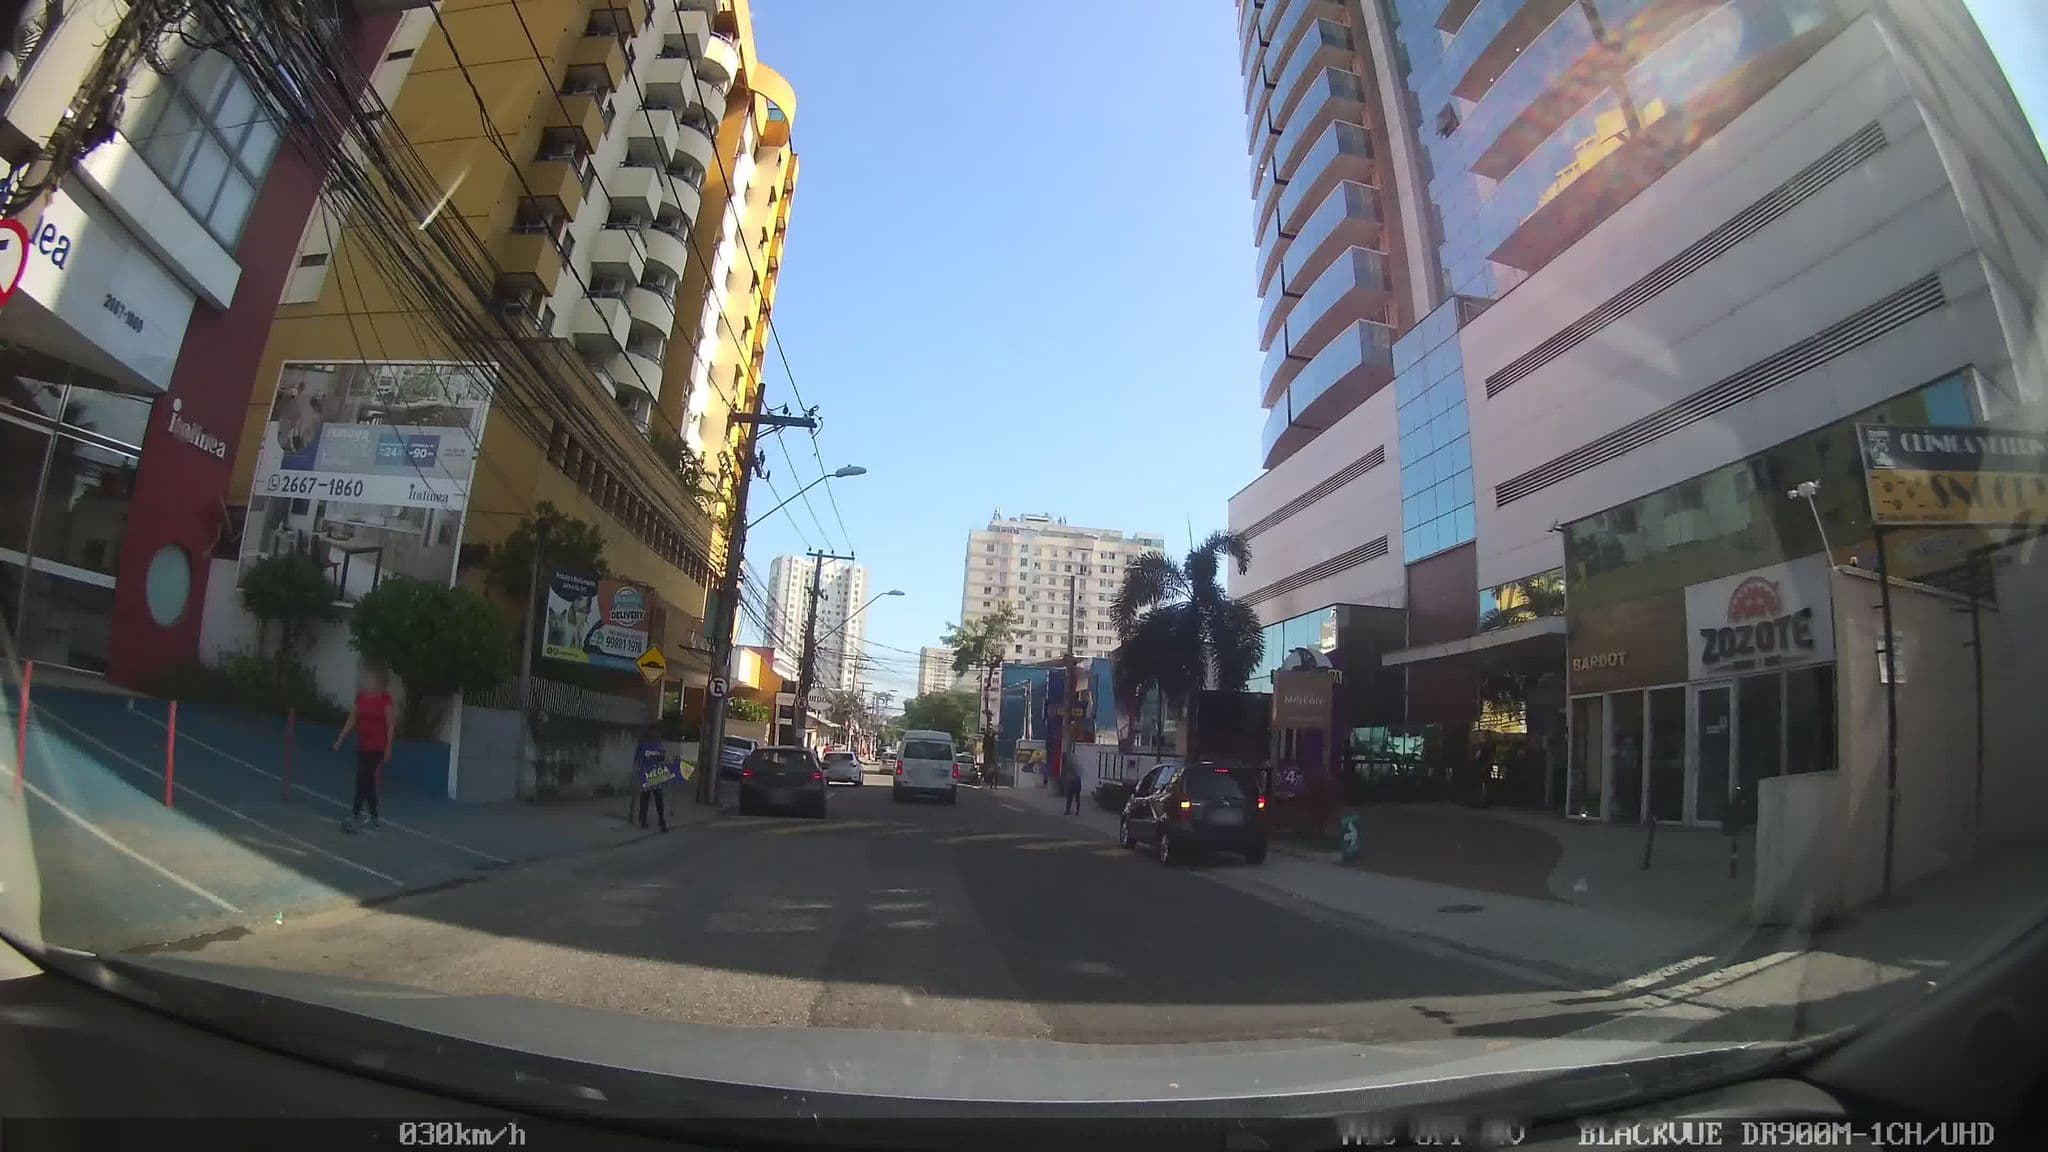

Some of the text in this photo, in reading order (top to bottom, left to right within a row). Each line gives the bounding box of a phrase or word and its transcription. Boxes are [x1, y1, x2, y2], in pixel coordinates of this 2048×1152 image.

[281, 474, 363, 498] 2667-1860
[610, 609, 645, 621] DELIVERY
[1699, 607, 1814, 665] ZOZOTE
[1572, 651, 1626, 672] BARDOT
